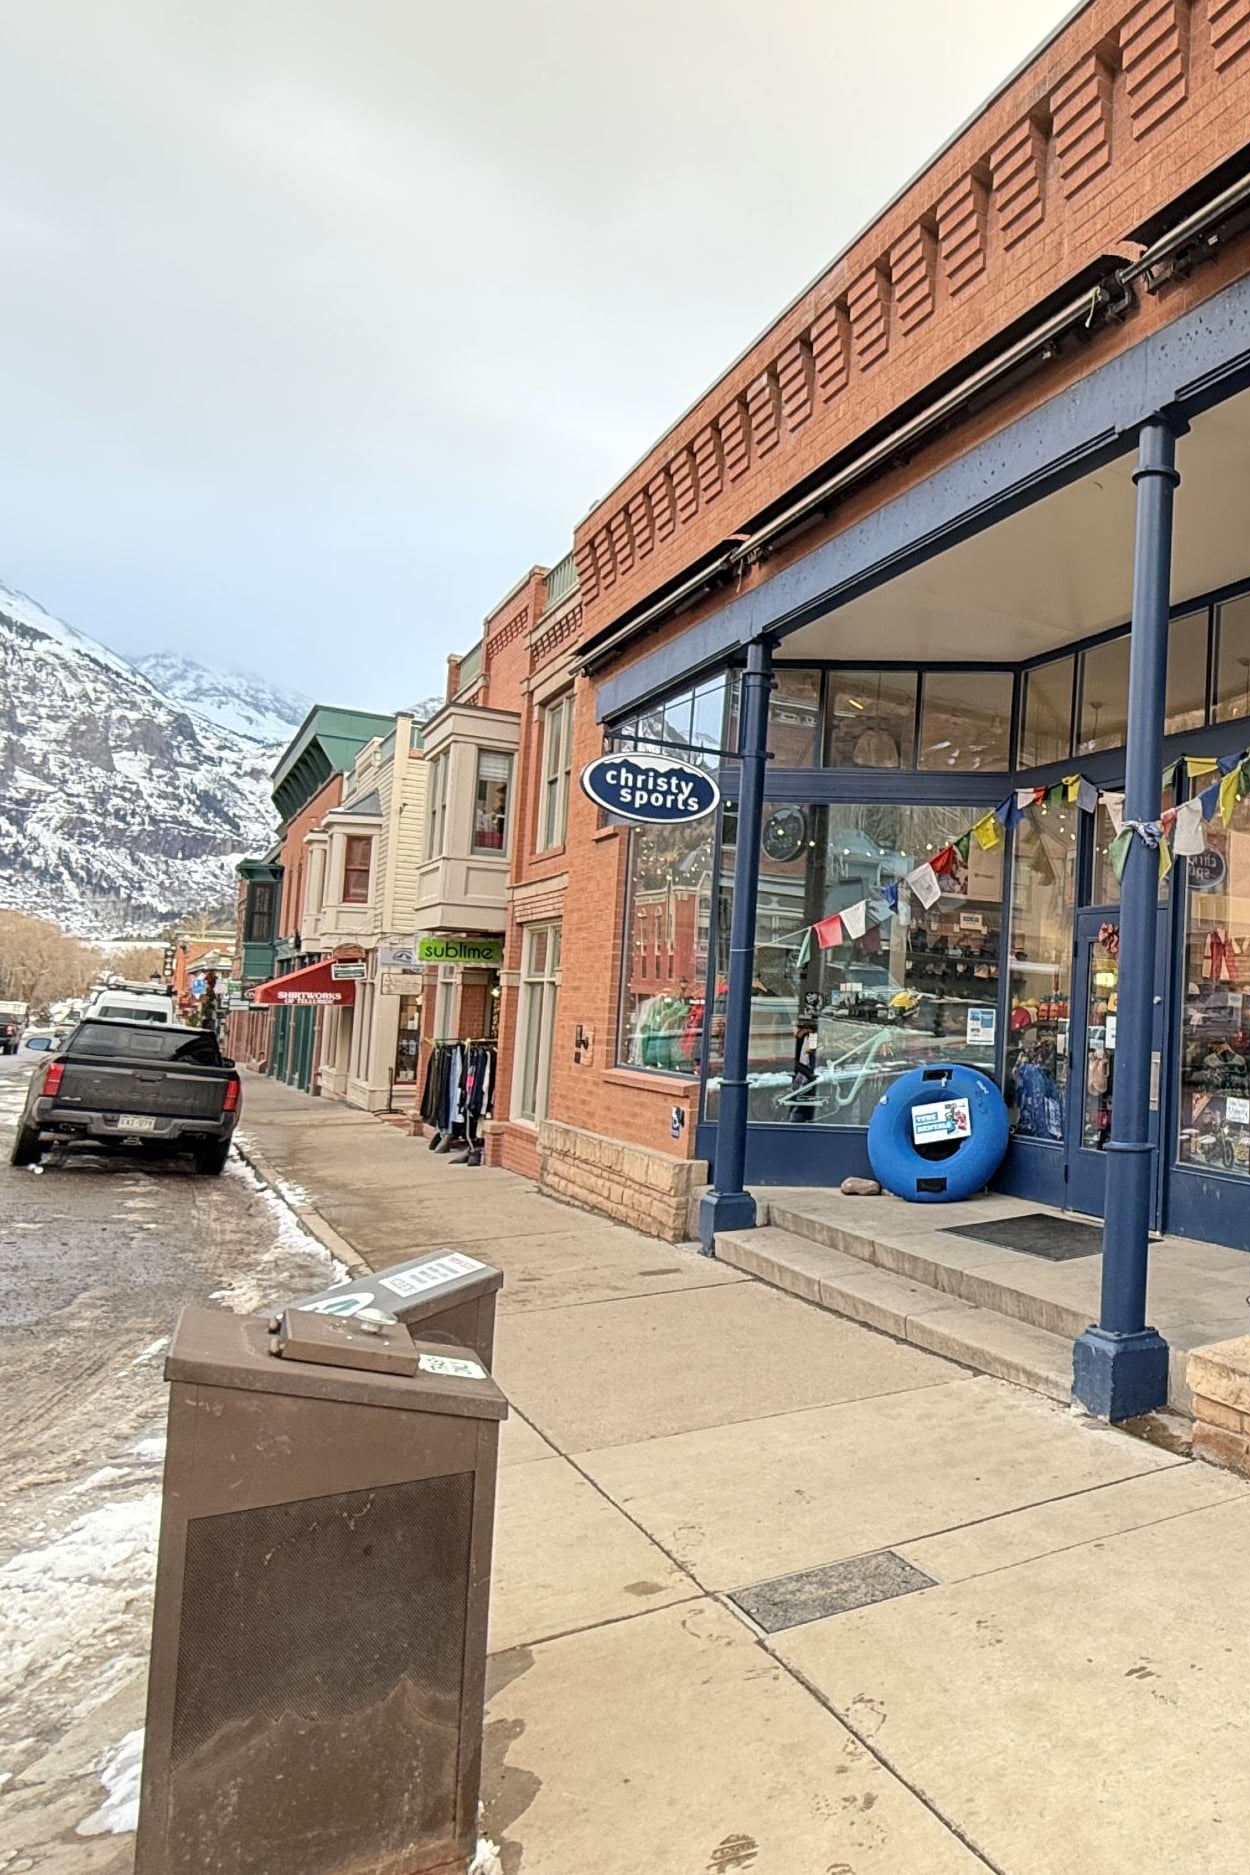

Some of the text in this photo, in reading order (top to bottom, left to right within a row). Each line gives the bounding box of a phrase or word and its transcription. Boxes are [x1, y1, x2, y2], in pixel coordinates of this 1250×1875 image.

[605, 767, 694, 800] christy
[619, 787, 700, 812] sports
[424, 942, 493, 960] sublime
[277, 991, 342, 1000] SHIRTWORKS
